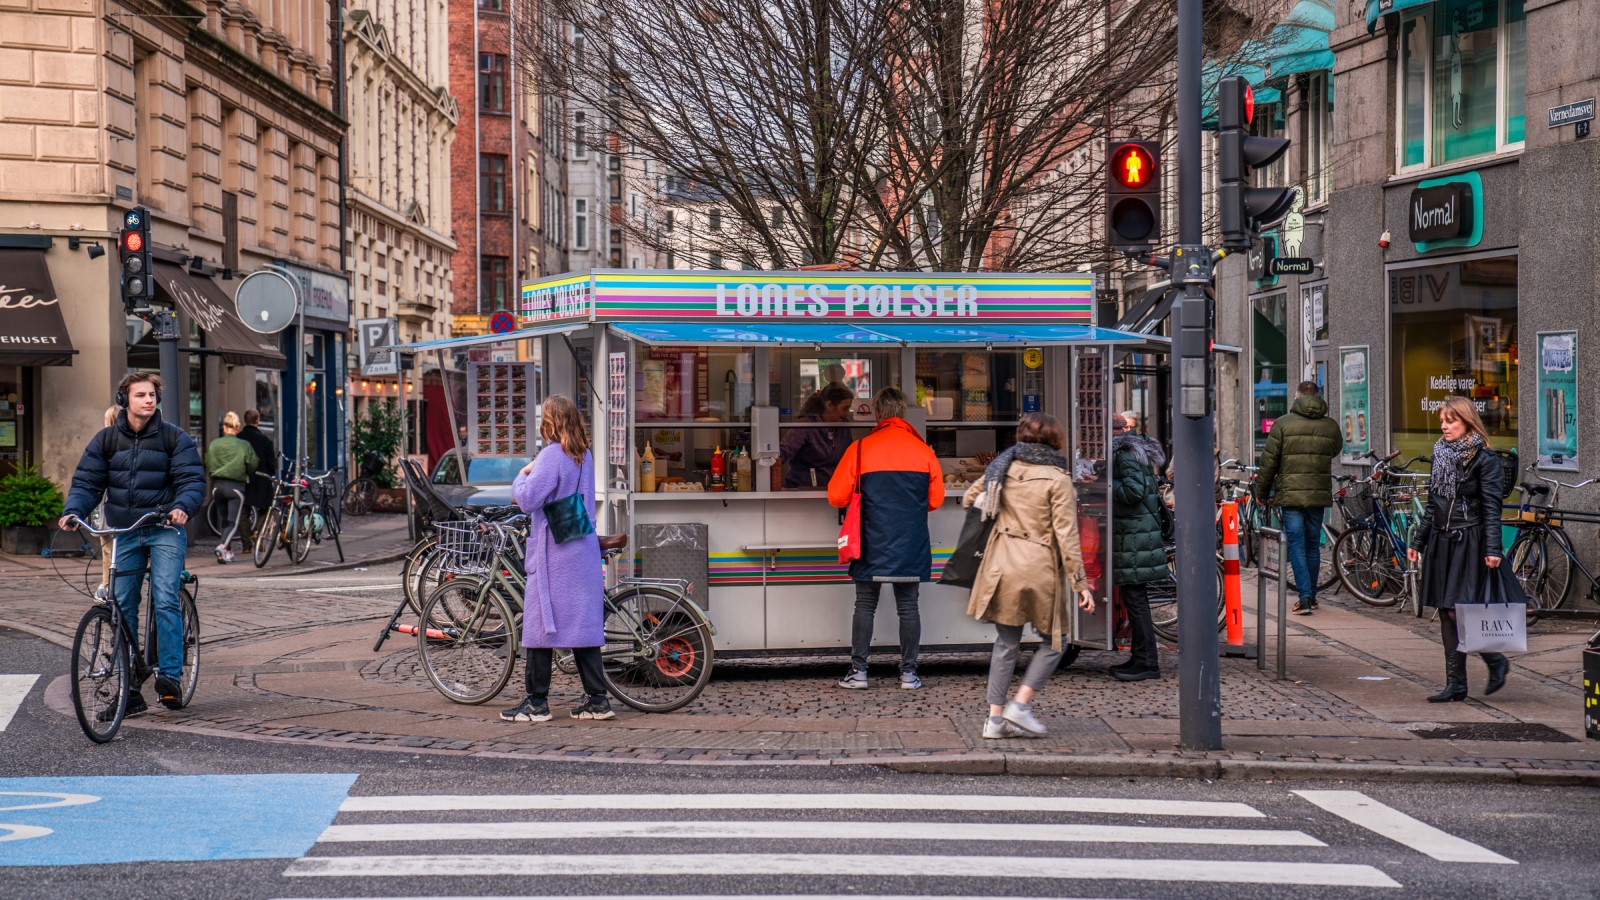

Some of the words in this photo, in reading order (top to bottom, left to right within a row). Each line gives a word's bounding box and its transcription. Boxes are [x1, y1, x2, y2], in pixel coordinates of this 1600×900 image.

[1550, 101, 1592, 121] Værnedamsvej
[1414, 194, 1454, 230] Normal
[1276, 261, 1309, 271] Normal
[716, 283, 829, 317] LONES
[845, 284, 978, 317] PØLSER
[1430, 375, 1457, 392] Kedelige
[1458, 378, 1476, 390] varer
[1481, 620, 1513, 631] RAVN
